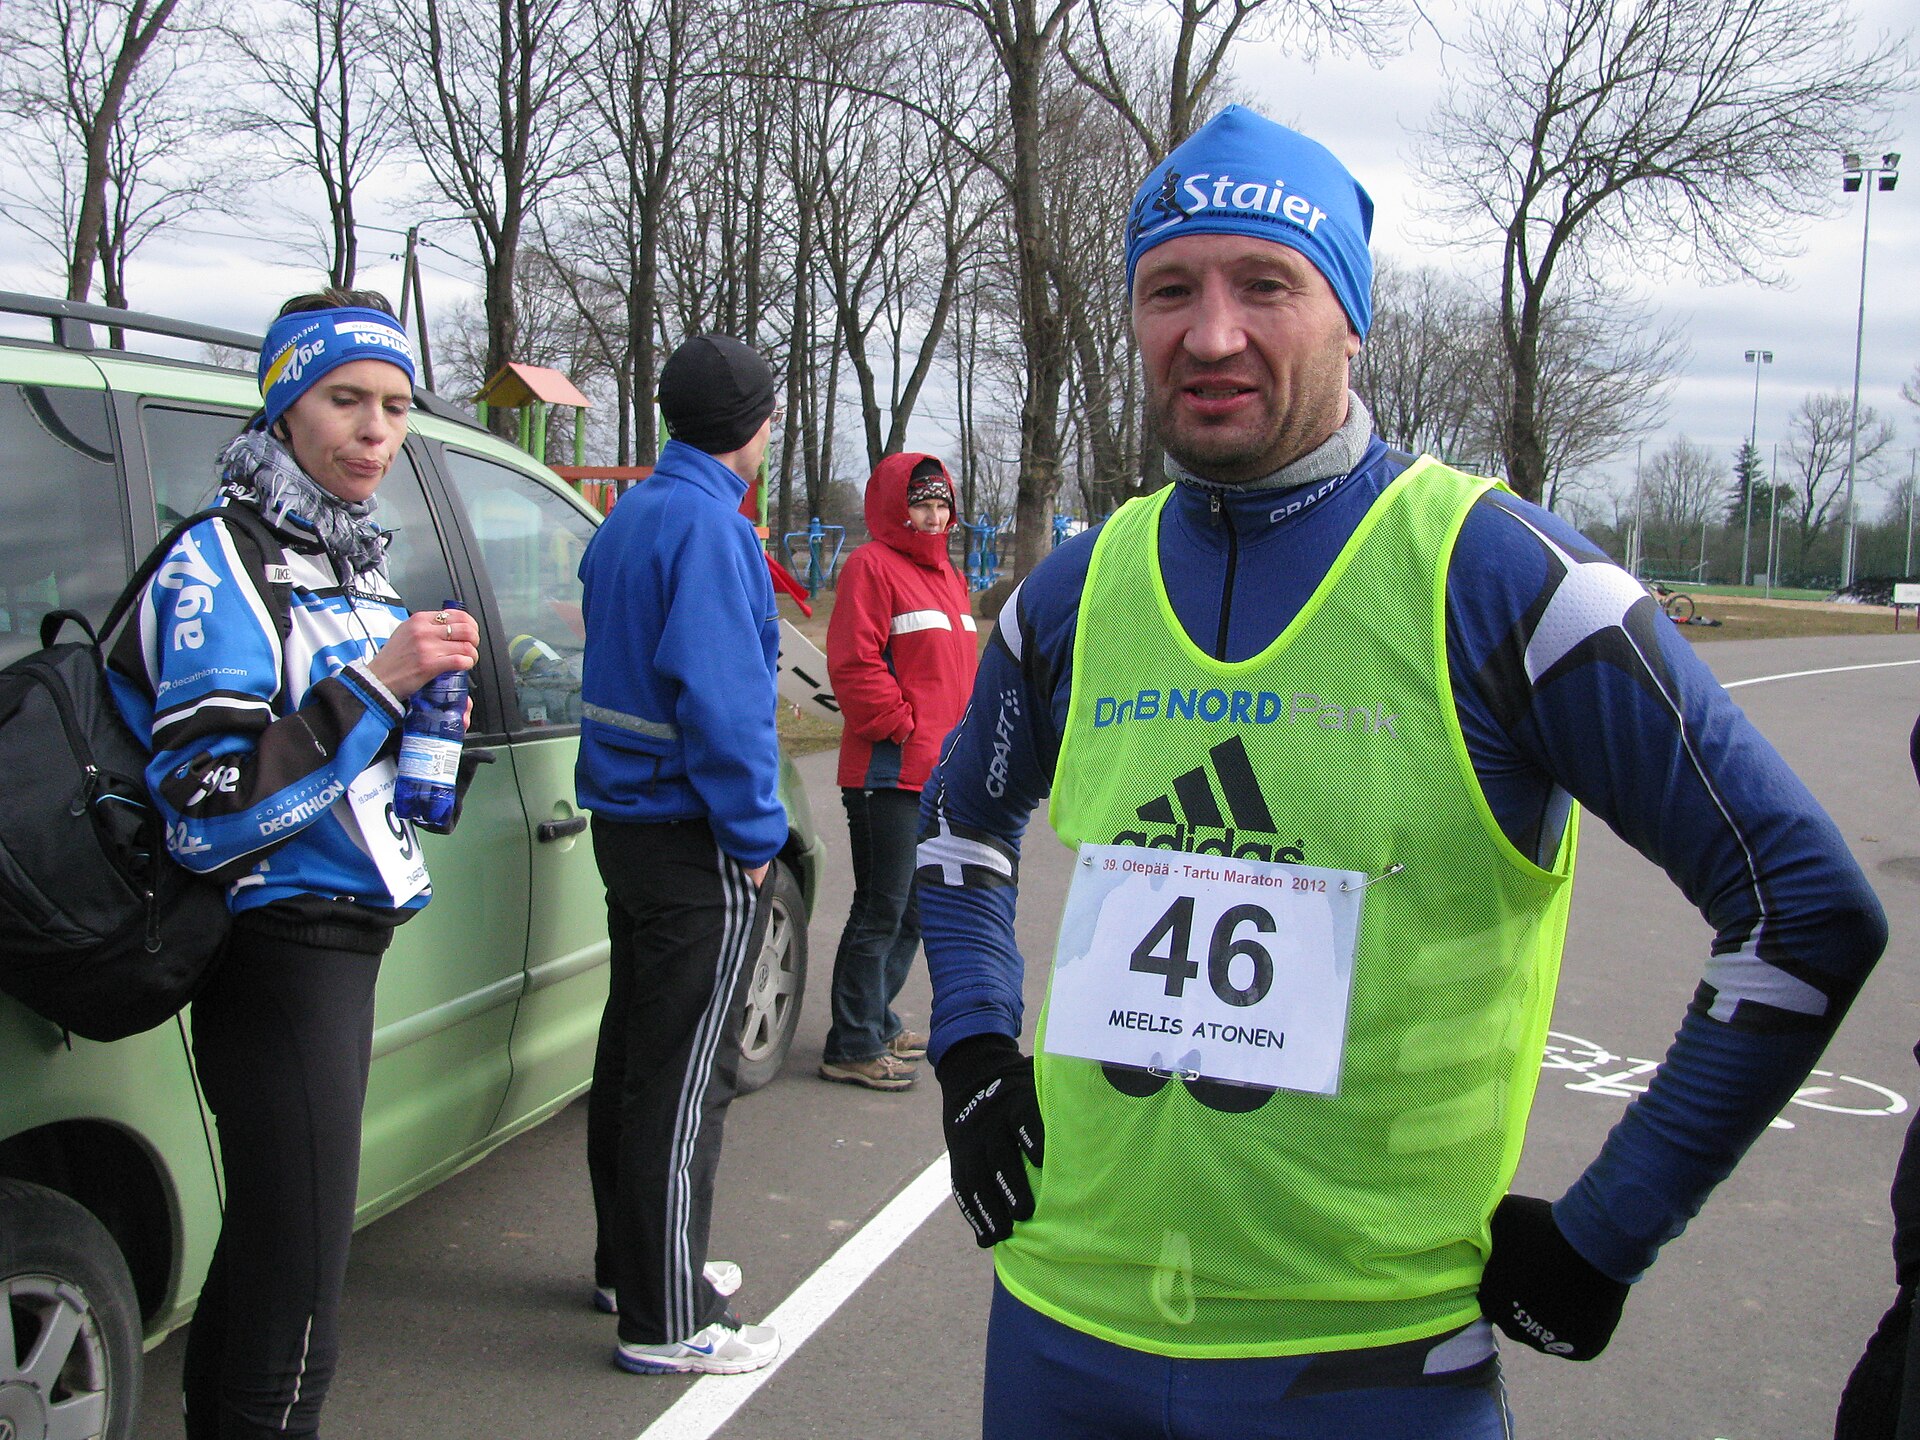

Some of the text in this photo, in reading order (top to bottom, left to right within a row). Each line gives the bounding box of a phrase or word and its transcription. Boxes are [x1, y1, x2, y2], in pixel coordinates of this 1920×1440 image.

[1183, 173, 1327, 233] Staier
[1208, 209, 1276, 223] VILJANDI
[1269, 477, 1340, 525] CRAFT
[172, 667, 248, 690] decathlon.com
[1288, 692, 1401, 739] Pank
[985, 705, 1015, 798] CRAFT
[255, 771, 335, 820] CONCEPTION
[259, 779, 345, 837] DECATHLON
[1102, 858, 1119, 871] 39.
[1122, 859, 1170, 876] Otepää
[1183, 865, 1220, 881] Tartu
[1223, 869, 1283, 888] Maraton
[1291, 877, 1327, 893] 2012
[1129, 895, 1277, 1007] 46
[1108, 1009, 1285, 1049] MEELIS ATONEN
[1018, 1125, 1034, 1149] bronx
[996, 1170, 1017, 1207] queens
[973, 1191, 996, 1234] brooklyn
